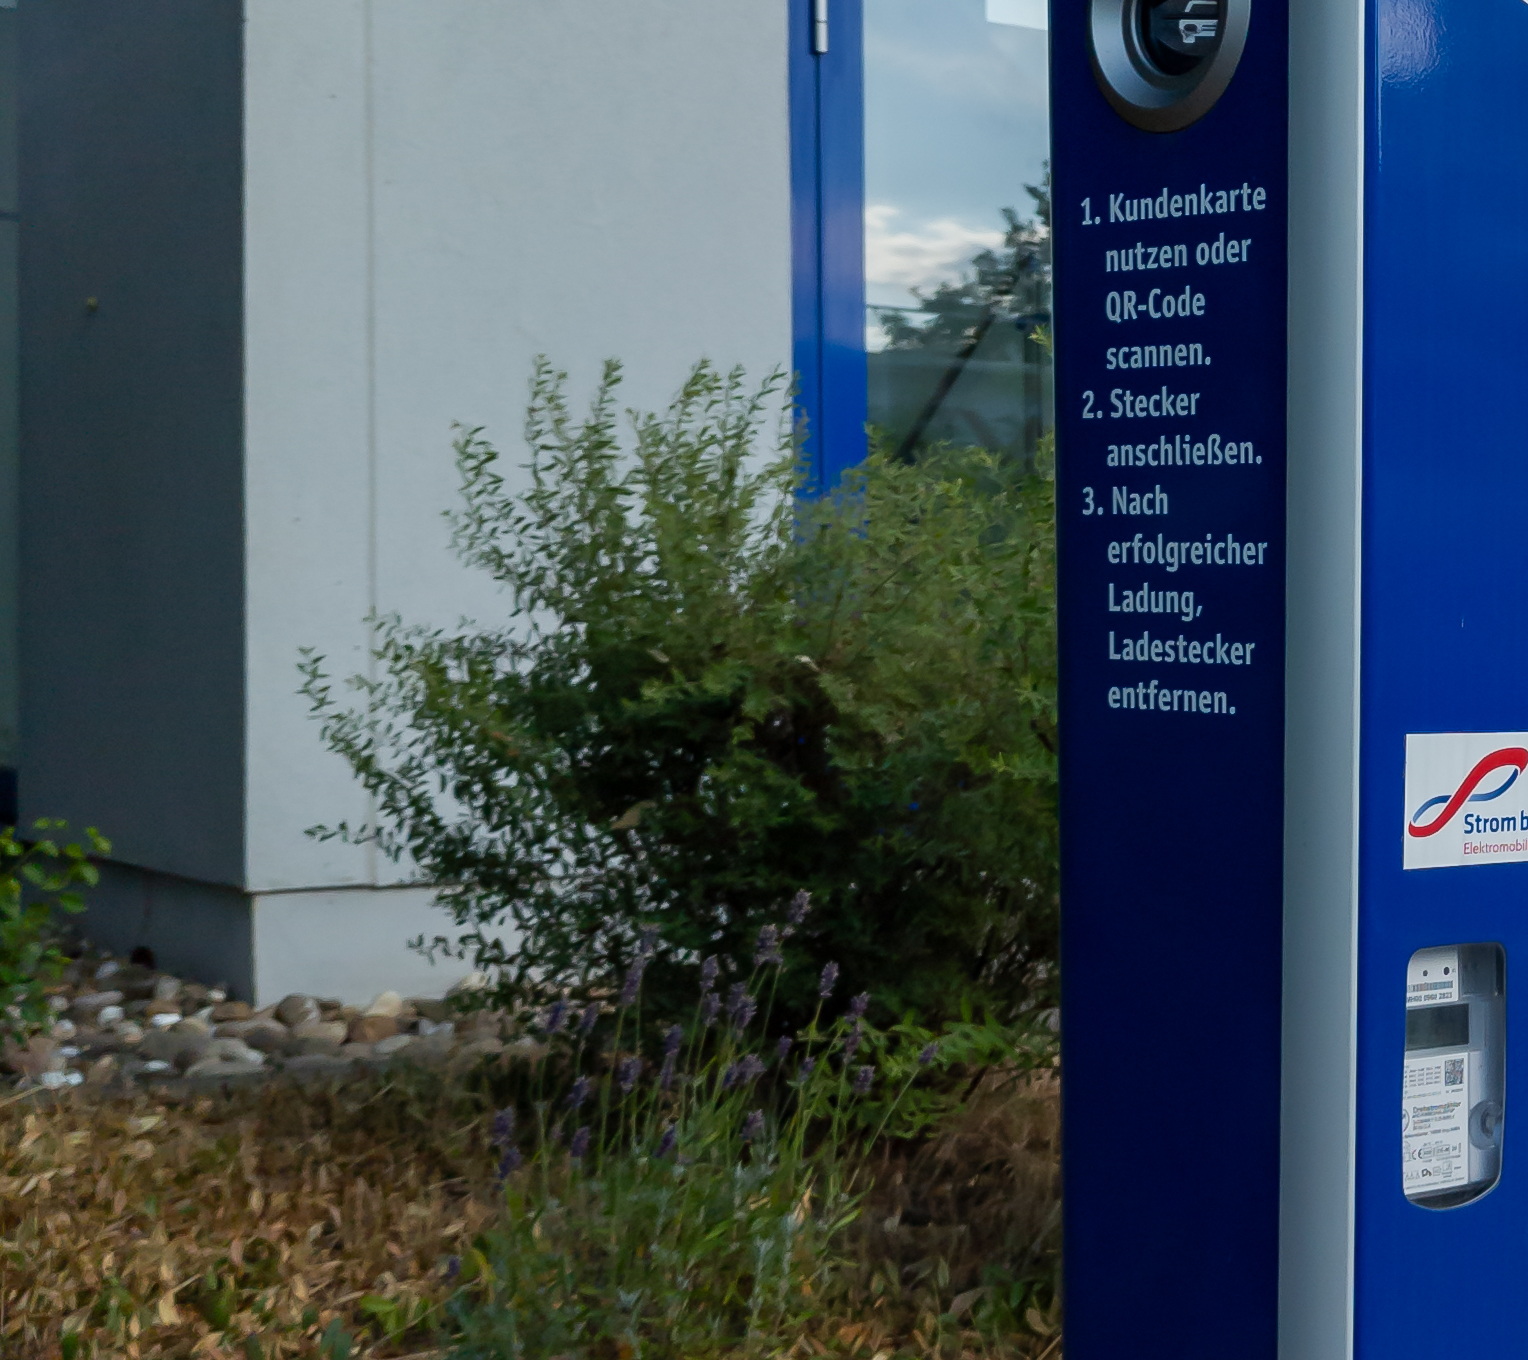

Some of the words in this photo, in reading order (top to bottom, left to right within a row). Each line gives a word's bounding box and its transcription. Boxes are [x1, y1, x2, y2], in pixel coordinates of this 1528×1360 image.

[1080, 197, 1101, 226] 1.
[1109, 182, 1267, 223] Kundenkarte
[1105, 241, 1188, 273] nutzen
[1195, 231, 1252, 266] oder
[1105, 284, 1206, 324] QR-Code
[1106, 343, 1212, 370] scannen.
[1082, 390, 1103, 419] 2.
[1110, 385, 1201, 419] Stecker
[1106, 433, 1263, 467] anschließen.
[1082, 486, 1104, 516] 3.
[1112, 484, 1169, 516] Nach
[1107, 532, 1268, 573] erfolgreicher
[1108, 581, 1203, 622] Ladung,
[1109, 630, 1256, 666] Ladestecker
[1108, 679, 1236, 715] entfernen.
[1463, 813, 1517, 835] Strom
